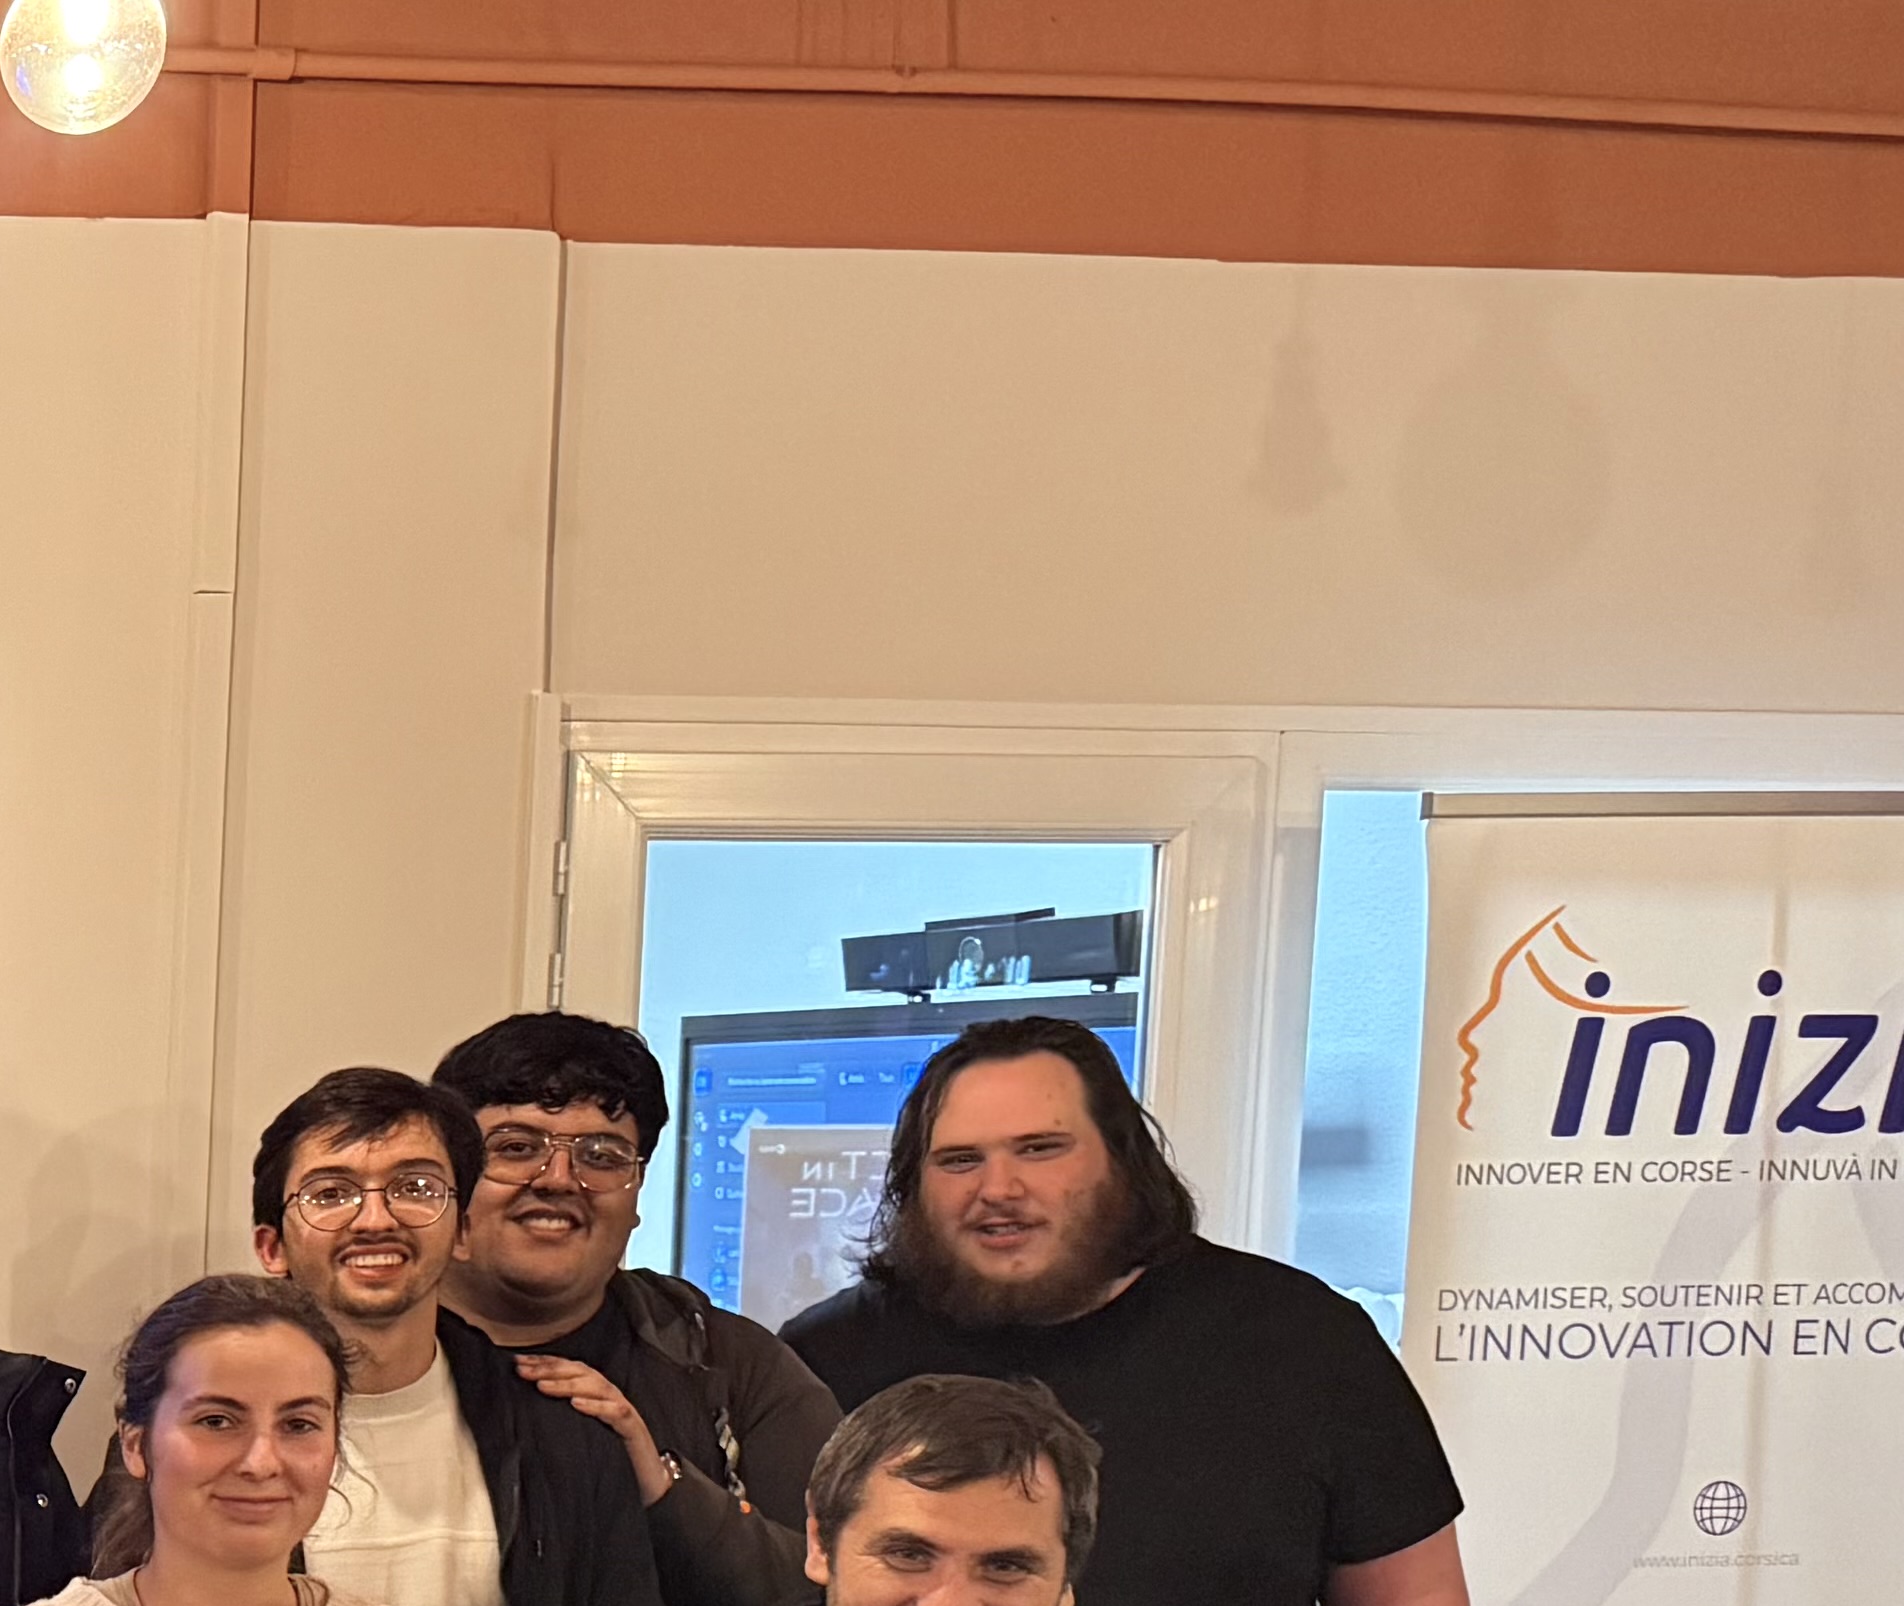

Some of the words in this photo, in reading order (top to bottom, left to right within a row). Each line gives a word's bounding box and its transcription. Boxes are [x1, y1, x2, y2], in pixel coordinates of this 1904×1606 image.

[1456, 1162, 1583, 1186] INNOVER
[1593, 1161, 1632, 1184] EN
[1641, 1159, 1733, 1183] CORSE
[1759, 1153, 1862, 1182] INNUVÀ
[1870, 1159, 1898, 1179] IN
[1437, 1286, 1614, 1313] DYNAMISER,
[1621, 1284, 1764, 1309] SOUTENIR
[1774, 1283, 1809, 1306] ET
[1435, 1320, 1773, 1362] L'INNOVATION
[1793, 1318, 1851, 1356] EN
[1865, 1318, 1904, 1354] C
